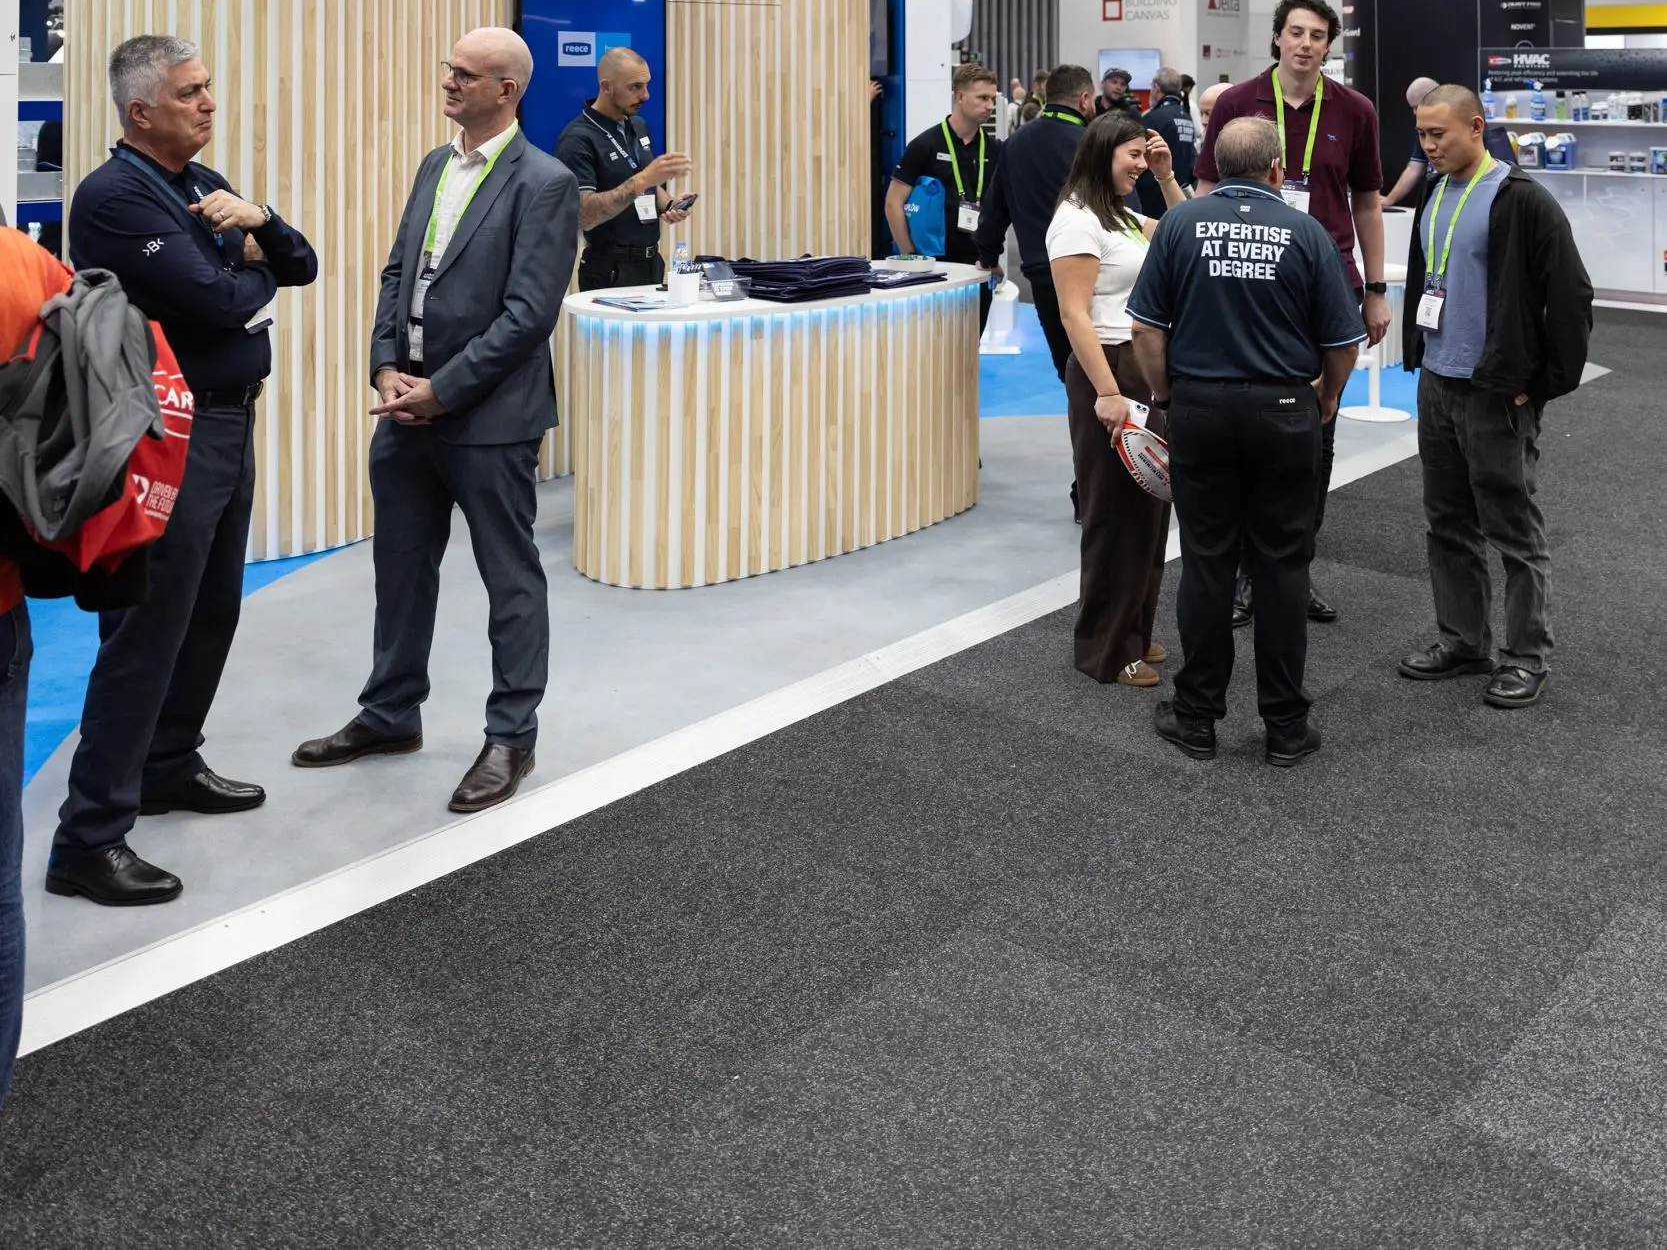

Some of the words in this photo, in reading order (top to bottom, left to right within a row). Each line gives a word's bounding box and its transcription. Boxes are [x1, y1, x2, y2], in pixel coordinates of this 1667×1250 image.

[1124, 9, 1170, 21] CANVAS
[565, 45, 588, 53] reece
[1513, 53, 1550, 64] HVAC
[1195, 221, 1292, 245] EXPERTISE
[1201, 240, 1223, 257] AT
[1227, 241, 1285, 262] EVERY
[1209, 259, 1276, 280] DEGREE
